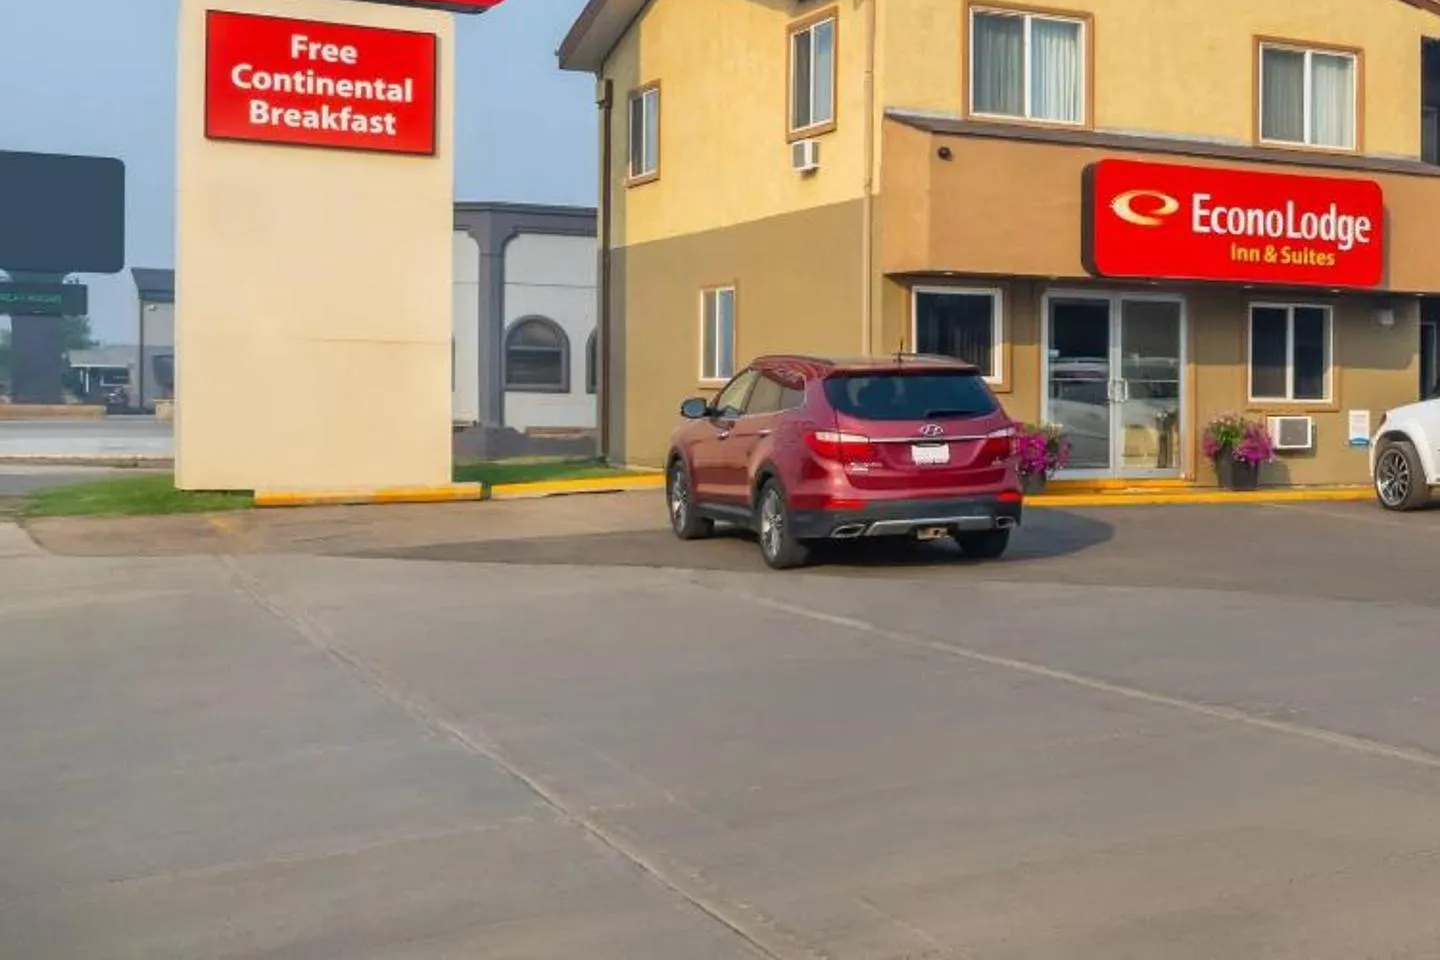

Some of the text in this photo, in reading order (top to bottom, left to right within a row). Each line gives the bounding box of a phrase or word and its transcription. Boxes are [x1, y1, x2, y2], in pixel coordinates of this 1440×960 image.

[291, 33, 359, 65] Free
[231, 62, 414, 103] Continental
[249, 98, 397, 136] Breakfast
[1192, 192, 1372, 251] EconoLodge
[1230, 242, 1336, 267] Inn & Suites
